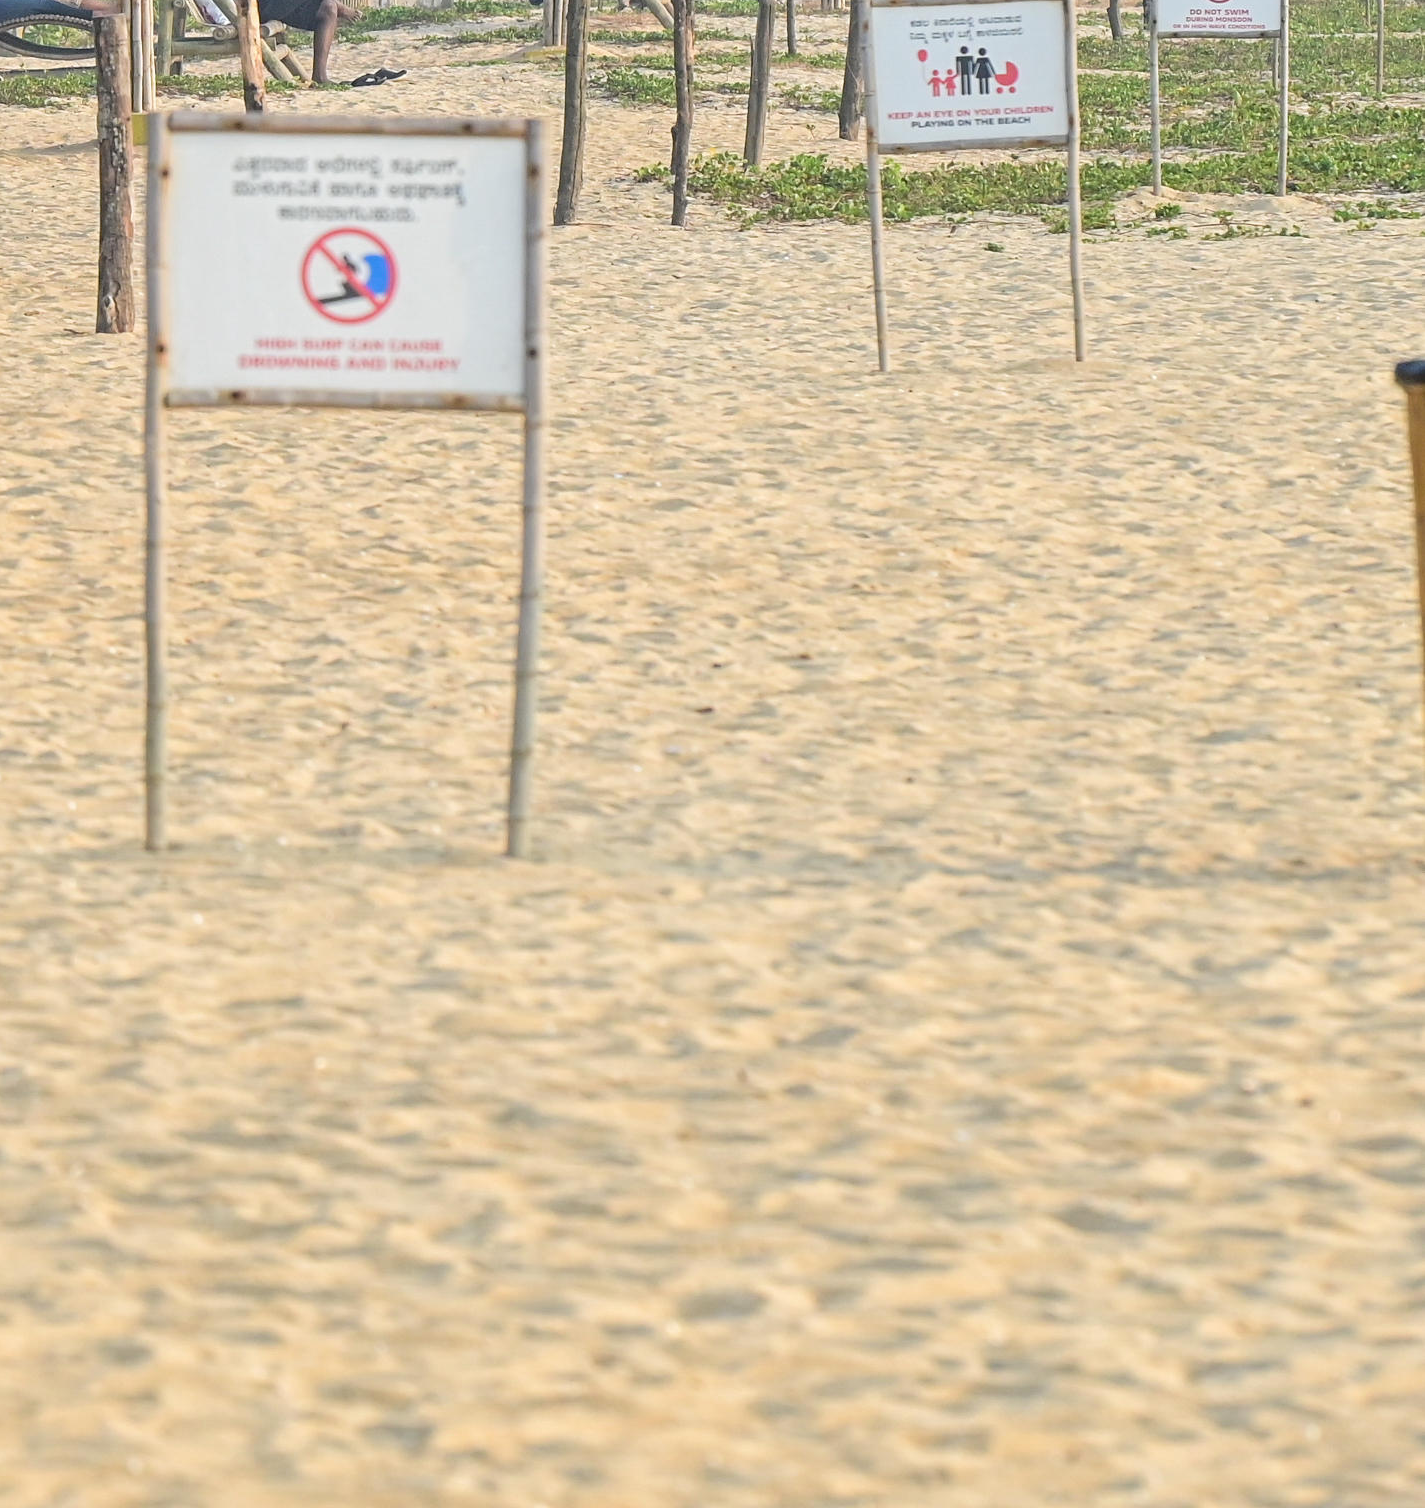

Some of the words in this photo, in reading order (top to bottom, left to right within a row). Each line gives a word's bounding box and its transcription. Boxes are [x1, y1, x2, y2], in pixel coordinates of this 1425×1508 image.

[887, 112, 913, 120] KEEP
[934, 110, 954, 118] EYE
[957, 109, 971, 117] ON
[975, 108, 1001, 116] YOUR
[1004, 106, 1054, 115] CHILDREN
[911, 120, 954, 128] PLAYING
[998, 117, 1031, 125] BEACH
[239, 355, 340, 370] DROWNING
[348, 356, 386, 370] AND
[393, 356, 459, 371] INJURY
